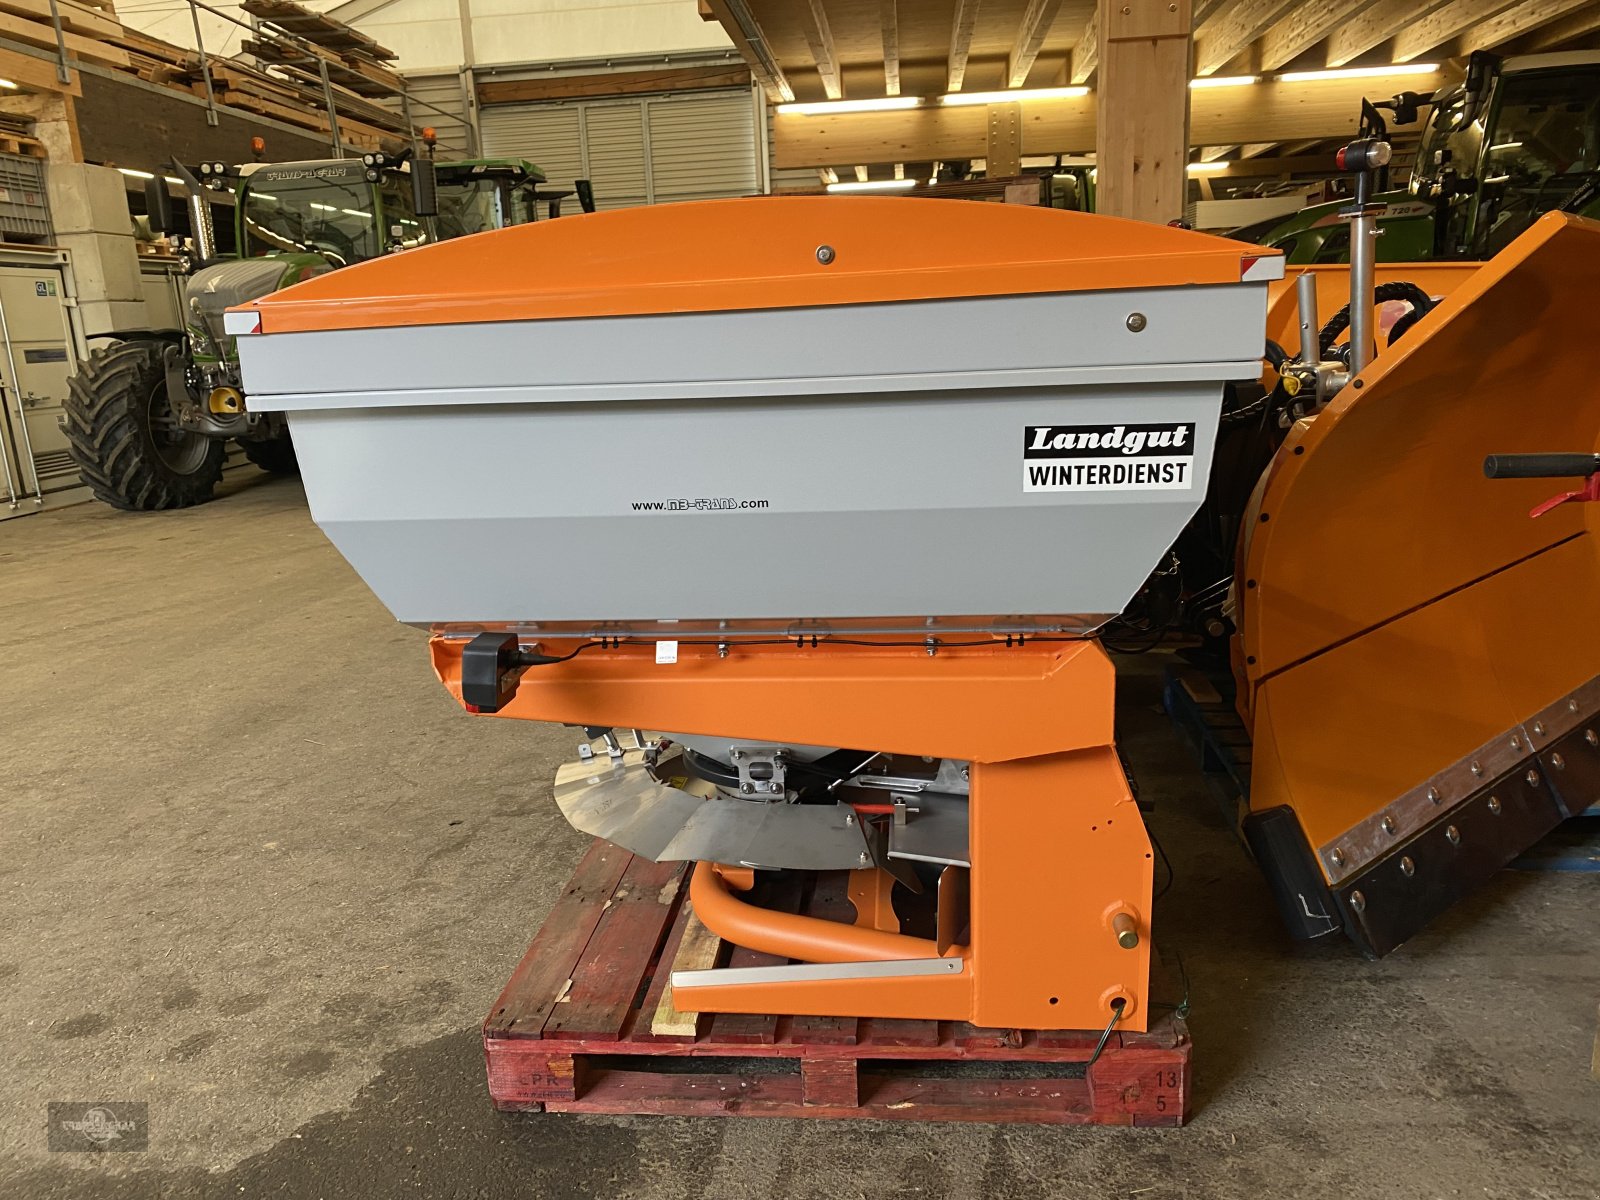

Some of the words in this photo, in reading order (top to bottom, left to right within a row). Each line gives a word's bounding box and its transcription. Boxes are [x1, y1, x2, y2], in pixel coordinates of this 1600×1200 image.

[1028, 425, 1189, 455] Landgut
[1029, 462, 1188, 487] WINTERDIENST
[1156, 1070, 1177, 1089] 13
[1156, 1095, 1167, 1112] 5
